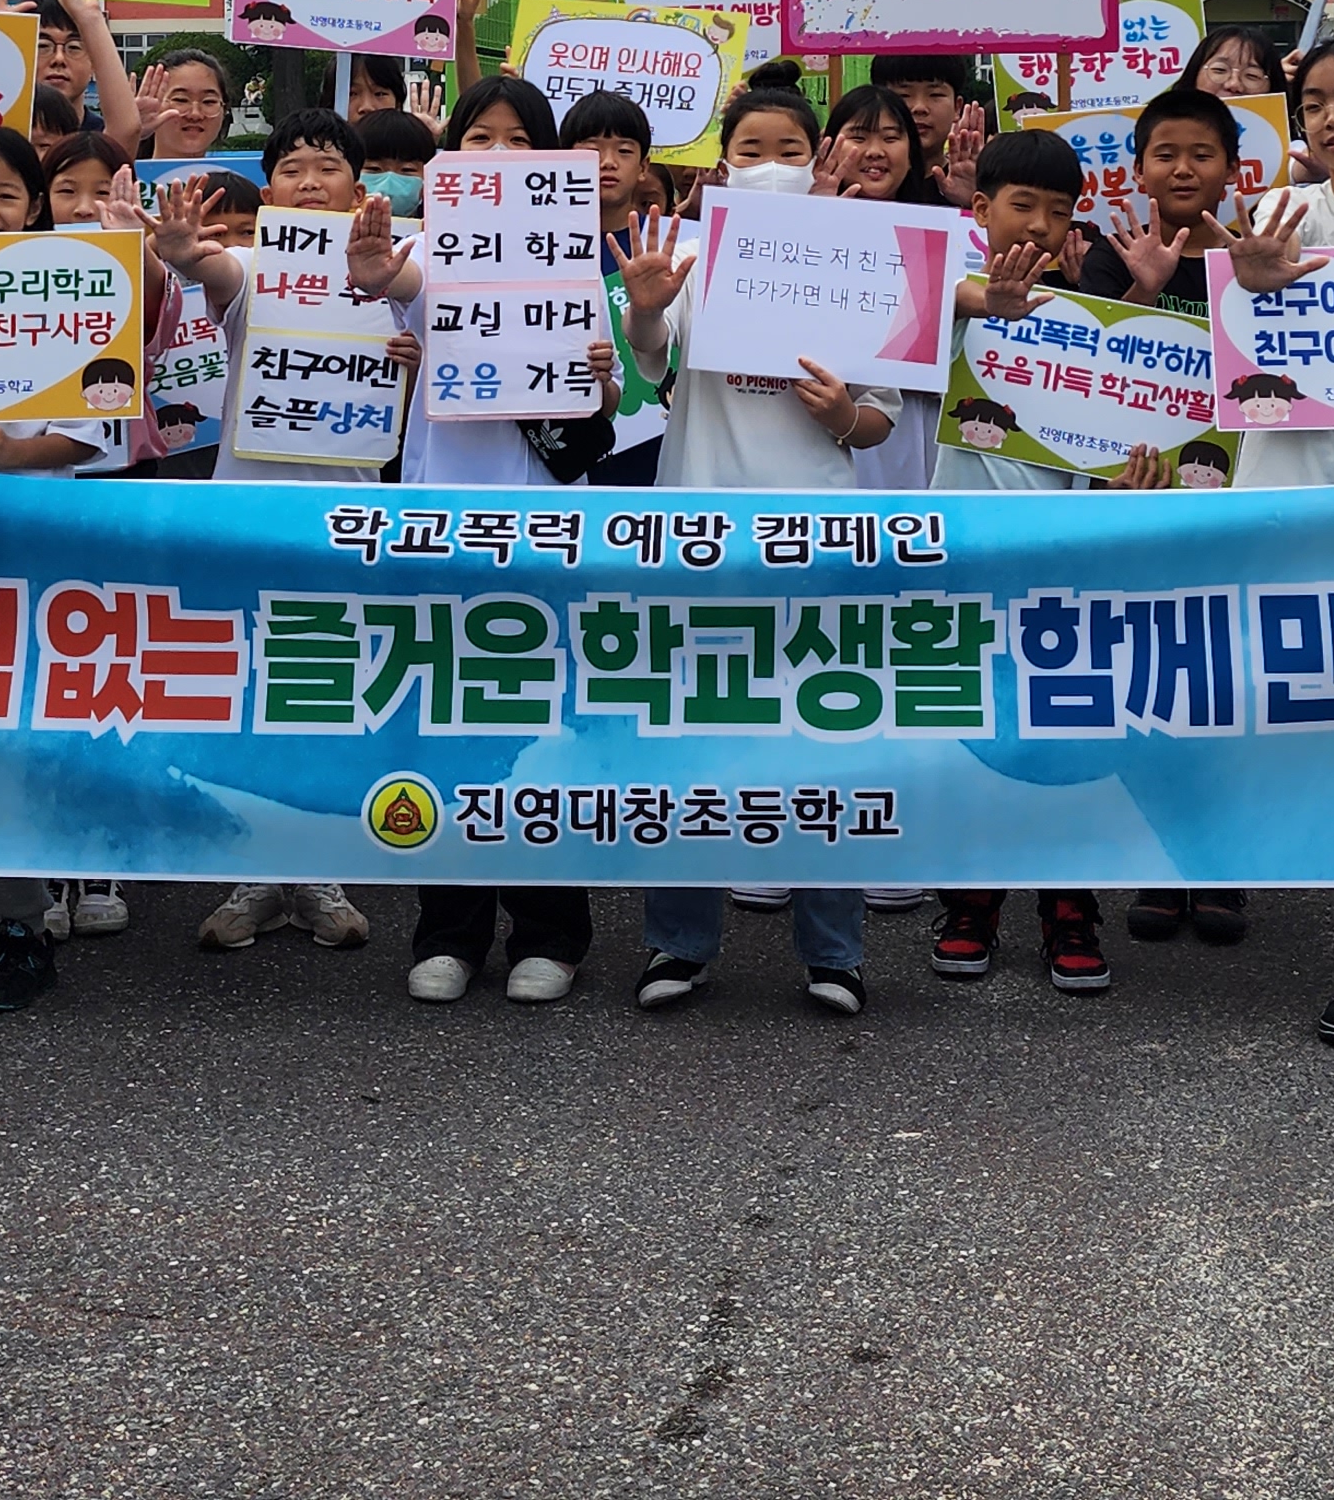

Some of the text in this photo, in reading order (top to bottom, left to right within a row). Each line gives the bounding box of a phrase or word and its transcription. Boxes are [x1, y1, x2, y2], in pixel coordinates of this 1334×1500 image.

[309, 14, 383, 32] 진영대창초등학교
[1123, 15, 1171, 43] 없는
[548, 42, 703, 79] 웃으며 인사해요
[1018, 46, 1184, 87] 행한 학교
[432, 170, 595, 208] 폭력 없는
[261, 224, 333, 255] 내가
[432, 232, 502, 265] 우리
[525, 231, 595, 266] 학교
[737, 237, 823, 267] 멀리있는
[829, 248, 850, 270] 저
[256, 271, 330, 306] 나쁜
[735, 277, 900, 316] 다가가면 내 친구
[431, 301, 502, 338] 교실
[524, 300, 597, 331] 마다
[149, 350, 228, 396] 웃음꽃
[251, 346, 399, 389] 친구에겐
[431, 361, 596, 400] 웃음 가득
[727, 374, 788, 391] GO PICNIC
[976, 350, 1093, 398] 웃음가득
[329, 508, 945, 567] 학교폭력 예방 캠페인
[43, 587, 240, 724] 없는
[262, 598, 556, 725] 즐거운
[578, 598, 995, 732] 학교생활
[1019, 596, 1234, 727] 함께
[455, 786, 902, 844] 진영대창초등학교
